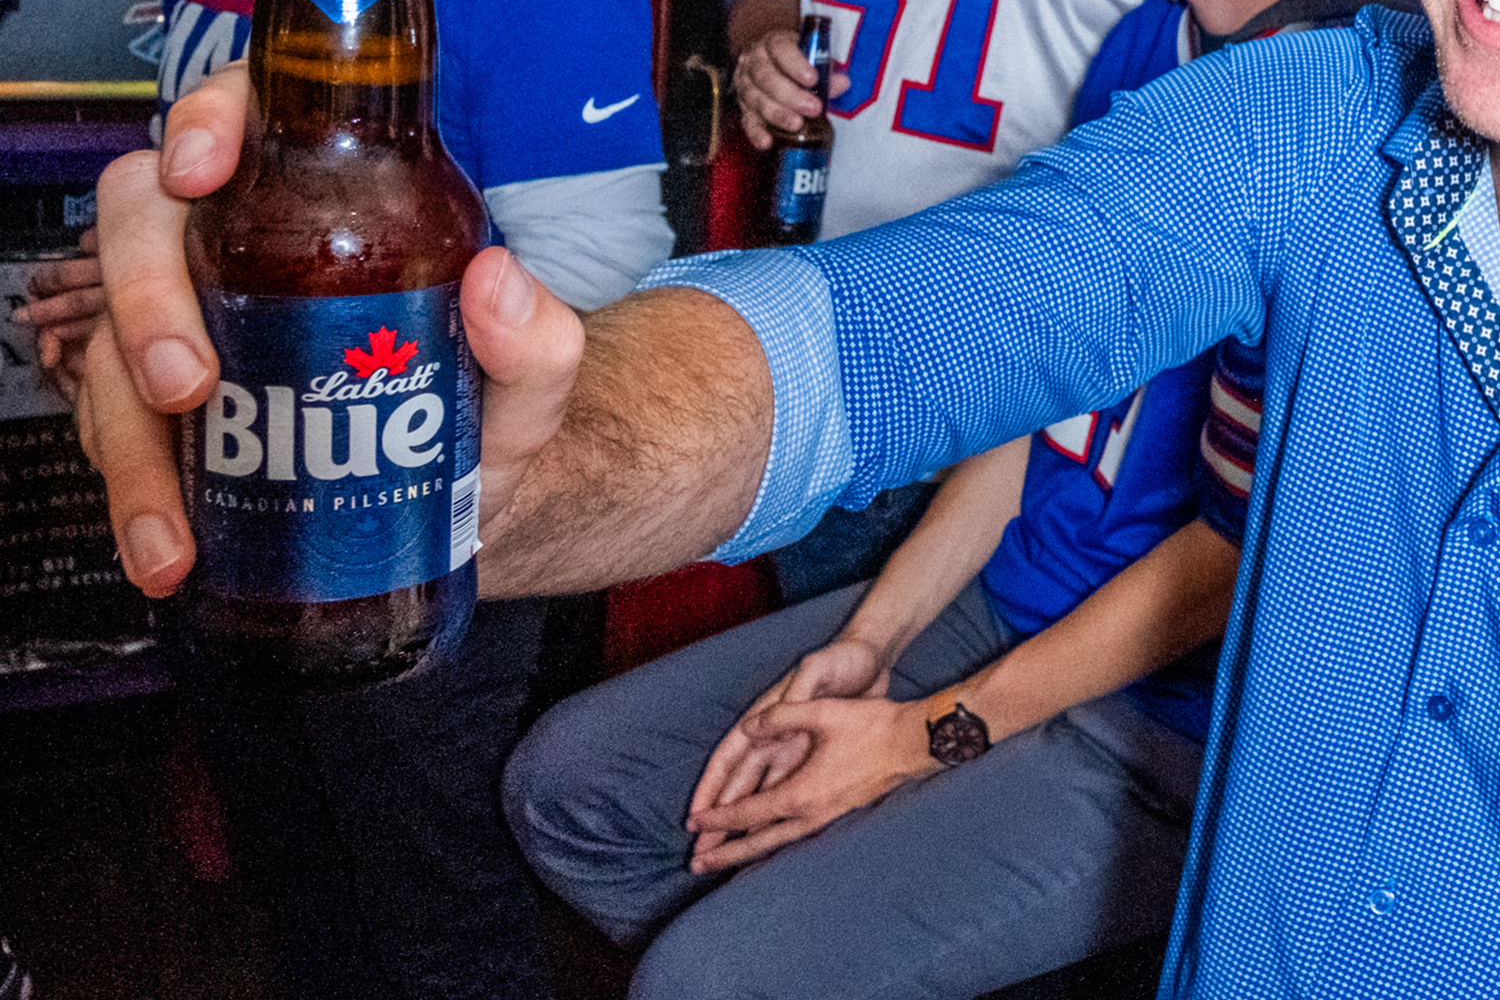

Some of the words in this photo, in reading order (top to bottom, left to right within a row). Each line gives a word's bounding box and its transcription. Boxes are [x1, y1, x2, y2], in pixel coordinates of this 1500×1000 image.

[301, 362, 440, 402] Labatt
[205, 380, 445, 481] Blue
[205, 488, 315, 513] CANADIAN
[333, 477, 443, 510] PILSENER
